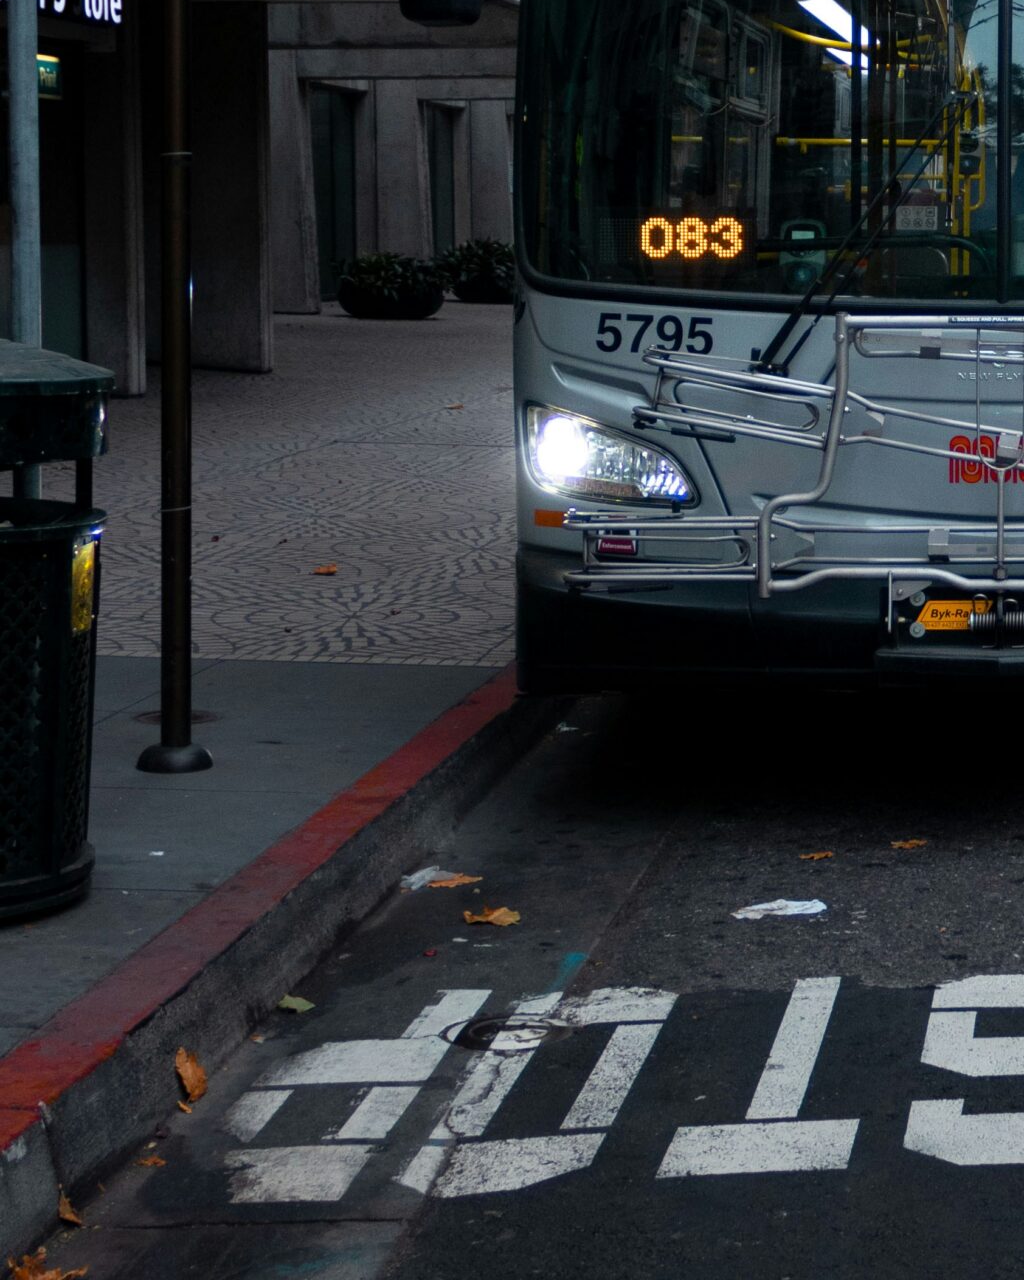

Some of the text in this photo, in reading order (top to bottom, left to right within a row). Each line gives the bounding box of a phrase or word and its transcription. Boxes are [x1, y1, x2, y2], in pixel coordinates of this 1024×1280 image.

[641, 216, 743, 259] 083
[595, 312, 714, 356] 5795
[930, 608, 974, 620] Byk-Ra
